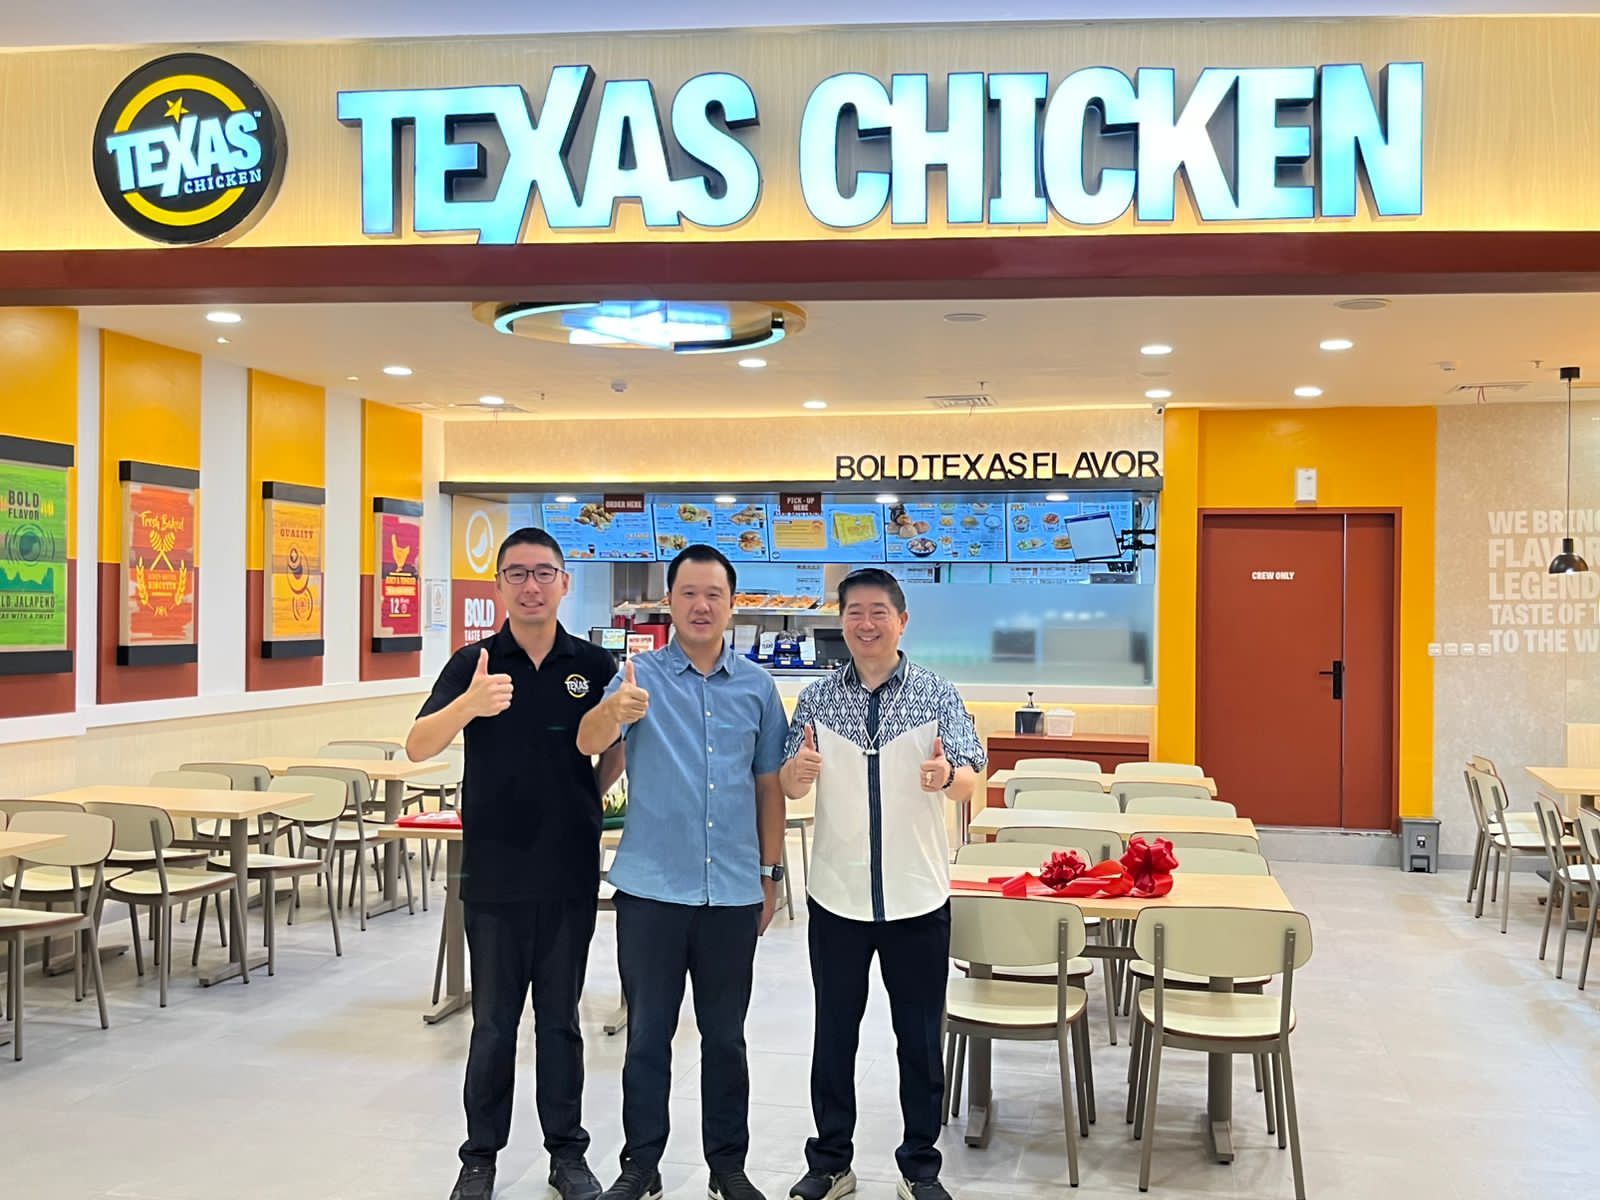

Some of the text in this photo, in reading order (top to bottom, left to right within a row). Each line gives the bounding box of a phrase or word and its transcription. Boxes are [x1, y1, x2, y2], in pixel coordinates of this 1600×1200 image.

[106, 111, 261, 198] TEXAS
[336, 61, 1424, 246] TEXAS CHICKEN
[183, 169, 262, 194] CHICKEN
[836, 449, 1161, 480] BOLD TEXAS FLAVOR
[8, 489, 40, 508] BOLD
[605, 500, 642, 508] ORDER HERE
[8, 508, 40, 521] FLAVOR
[1487, 511, 1529, 534] WE
[280, 528, 314, 539] QUALITY
[1251, 571, 1295, 580] CREW ONLY
[390, 598, 401, 614] 12
[464, 598, 495, 628] BOLD
[1488, 603, 1554, 625] TASTE
[1558, 602, 1586, 625] OF
[1488, 628, 1520, 654] TO
[1522, 628, 1569, 654] THE
[564, 679, 590, 693] TEXAS
